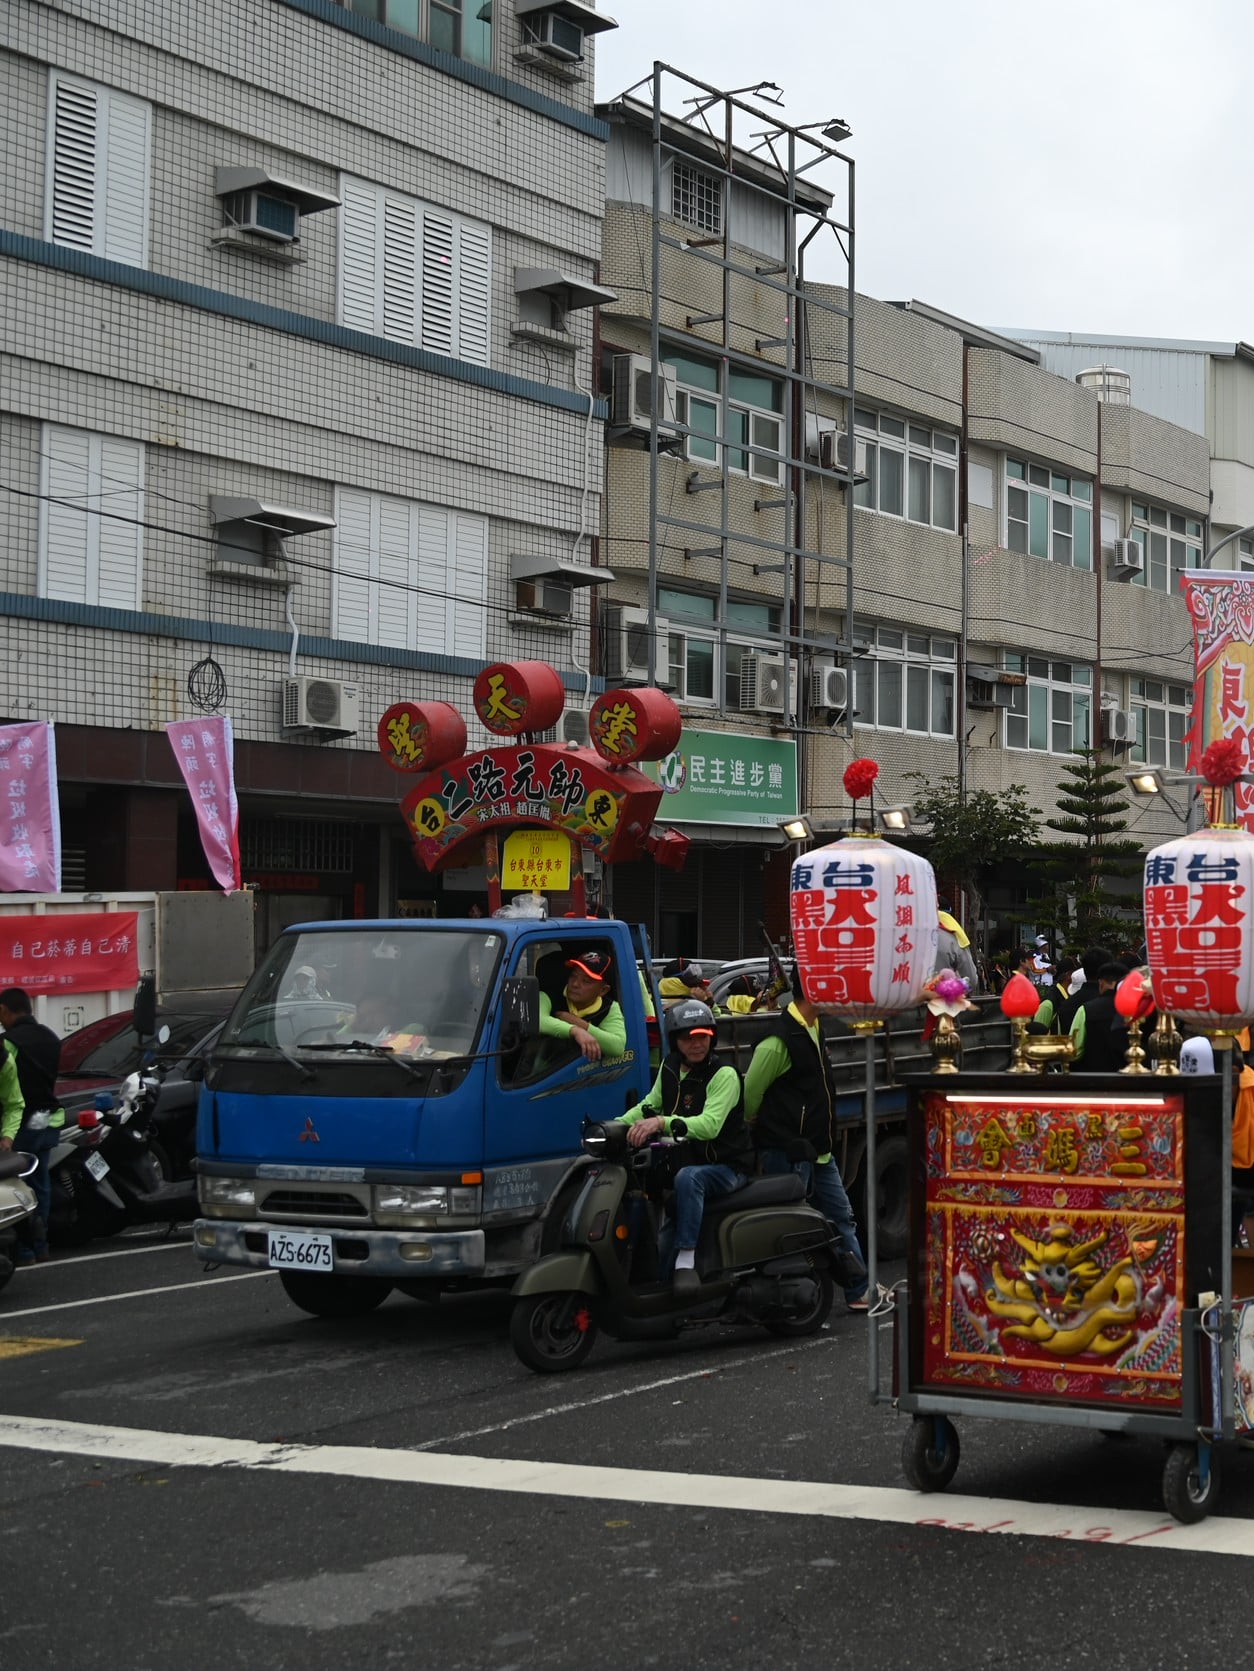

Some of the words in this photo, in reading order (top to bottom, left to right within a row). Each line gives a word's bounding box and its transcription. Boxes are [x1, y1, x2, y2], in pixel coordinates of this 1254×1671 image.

[486, 673, 522, 721] 天
[690, 755, 783, 788] 民主進步黨
[690, 785, 718, 794] Democratic
[718, 787, 746, 797] Progressive
[747, 790, 759, 799] Party
[522, 874, 548, 887] 聖天堂
[892, 873, 915, 985] 風調雨順
[13, 935, 131, 959] 自己菸蒂自己清
[270, 1240, 331, 1265] AZS-6673
